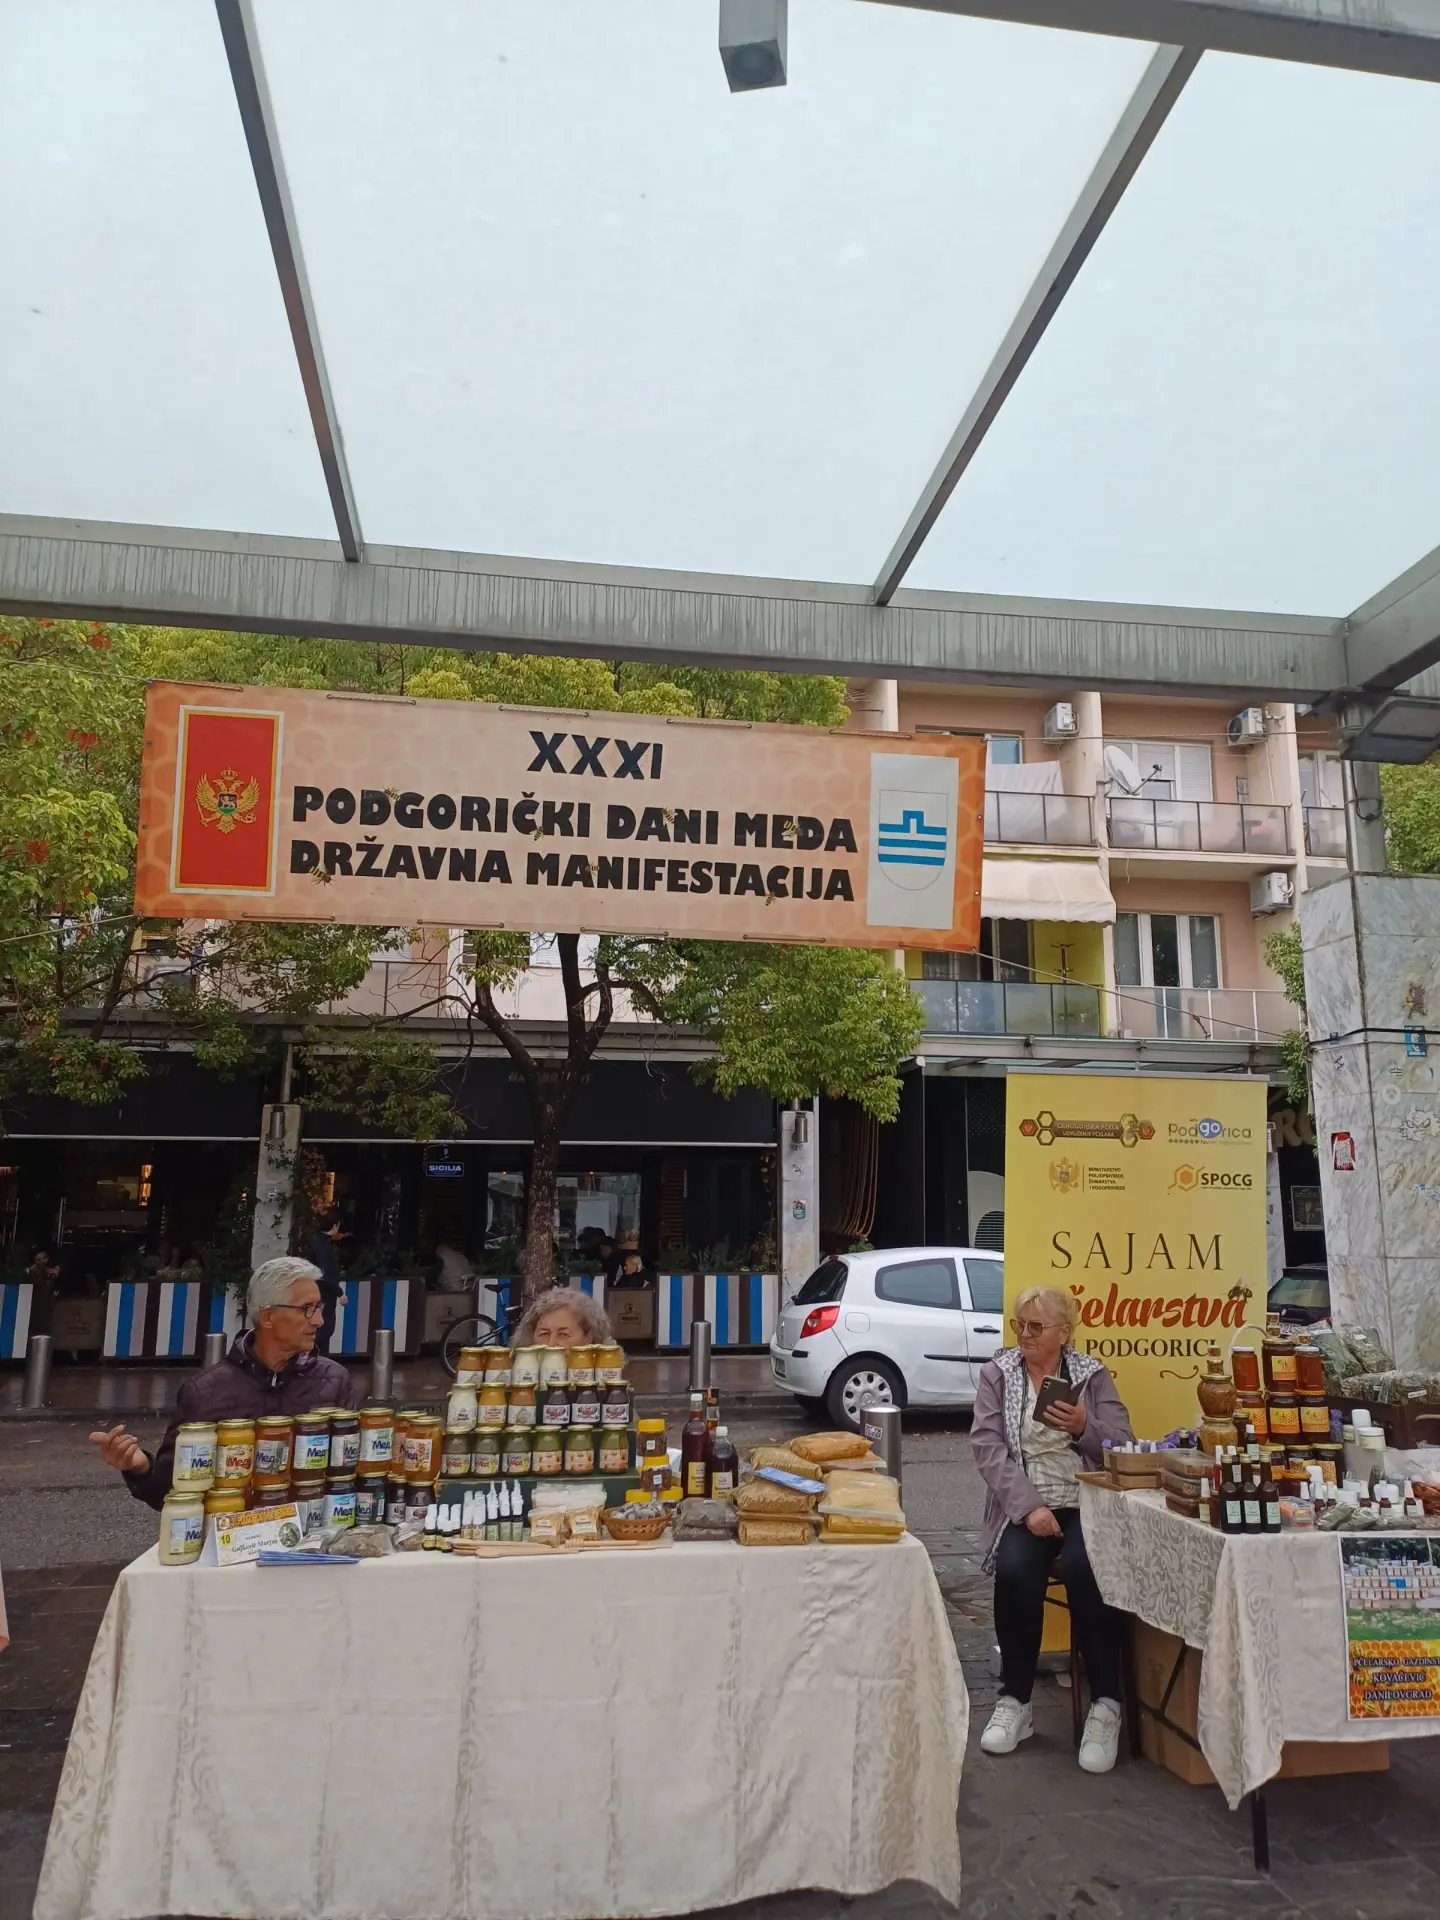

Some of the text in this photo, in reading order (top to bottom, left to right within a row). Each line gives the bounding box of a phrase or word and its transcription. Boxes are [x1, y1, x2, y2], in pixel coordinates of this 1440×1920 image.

[526, 730, 664, 780] XXXI
[292, 785, 859, 853] PODGORIČKI DANI MEDA
[289, 835, 855, 902] DRŽAVNA MANIFESTACIJA
[1168, 1122, 1252, 1139] Podgorica
[1201, 1173, 1252, 1186] SPOCG
[1051, 1231, 1224, 1276] SAJAM
[221, 1534, 231, 1545] 10
[1364, 1690, 1433, 1700] DANILOVGRAD
